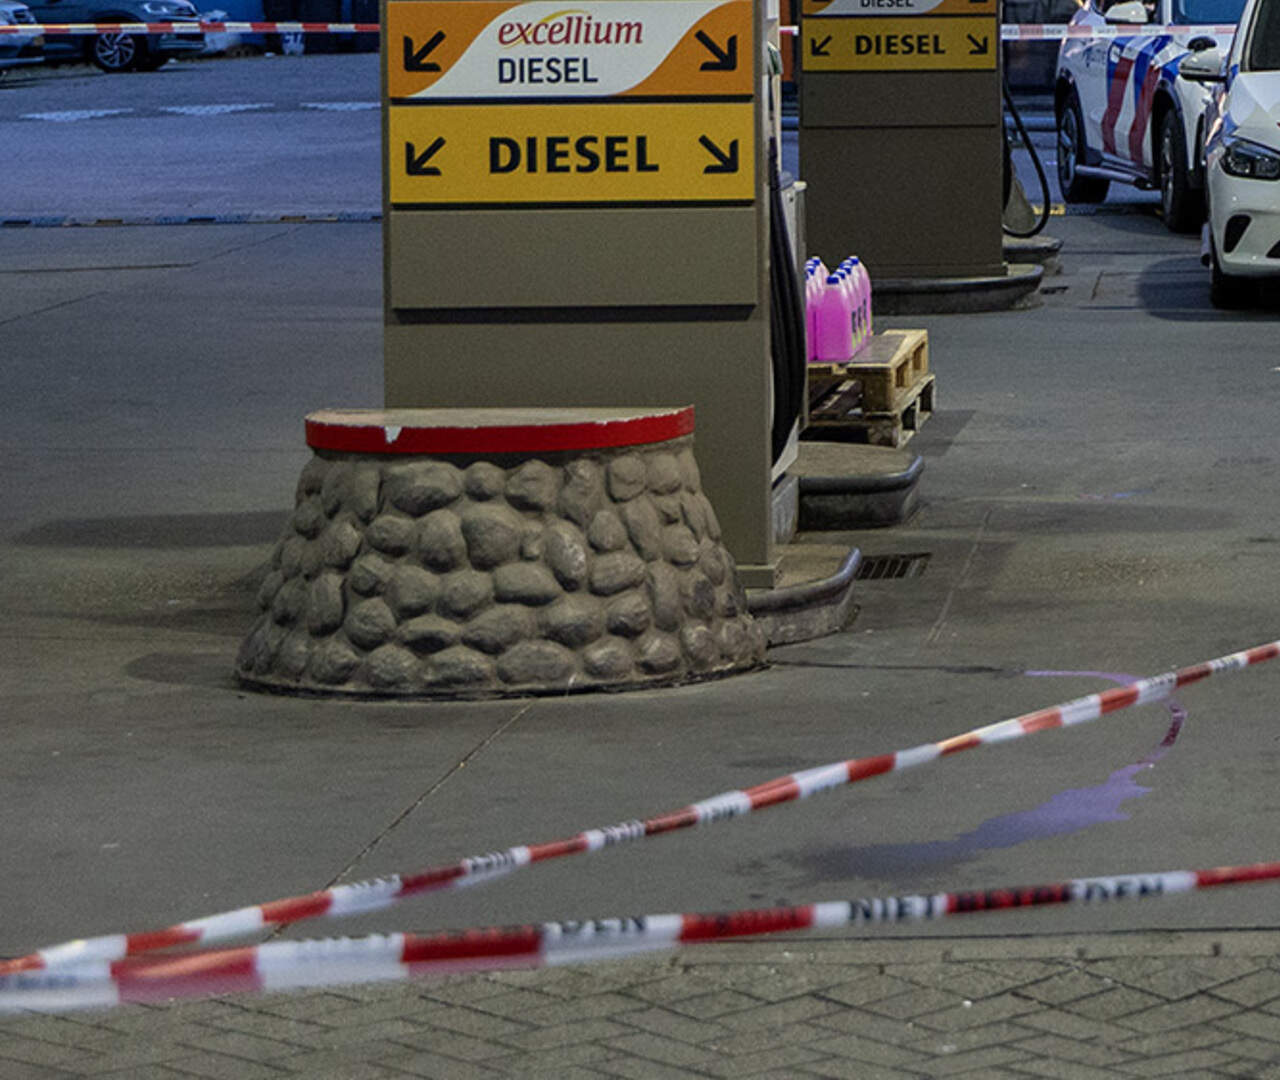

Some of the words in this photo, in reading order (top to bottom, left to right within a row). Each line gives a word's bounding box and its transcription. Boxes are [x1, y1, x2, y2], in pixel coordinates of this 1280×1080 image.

[498, 17, 643, 47] excellium
[855, 35, 946, 55] DIESEL
[498, 57, 598, 84] DIESEL
[489, 135, 660, 174] DIESEL
